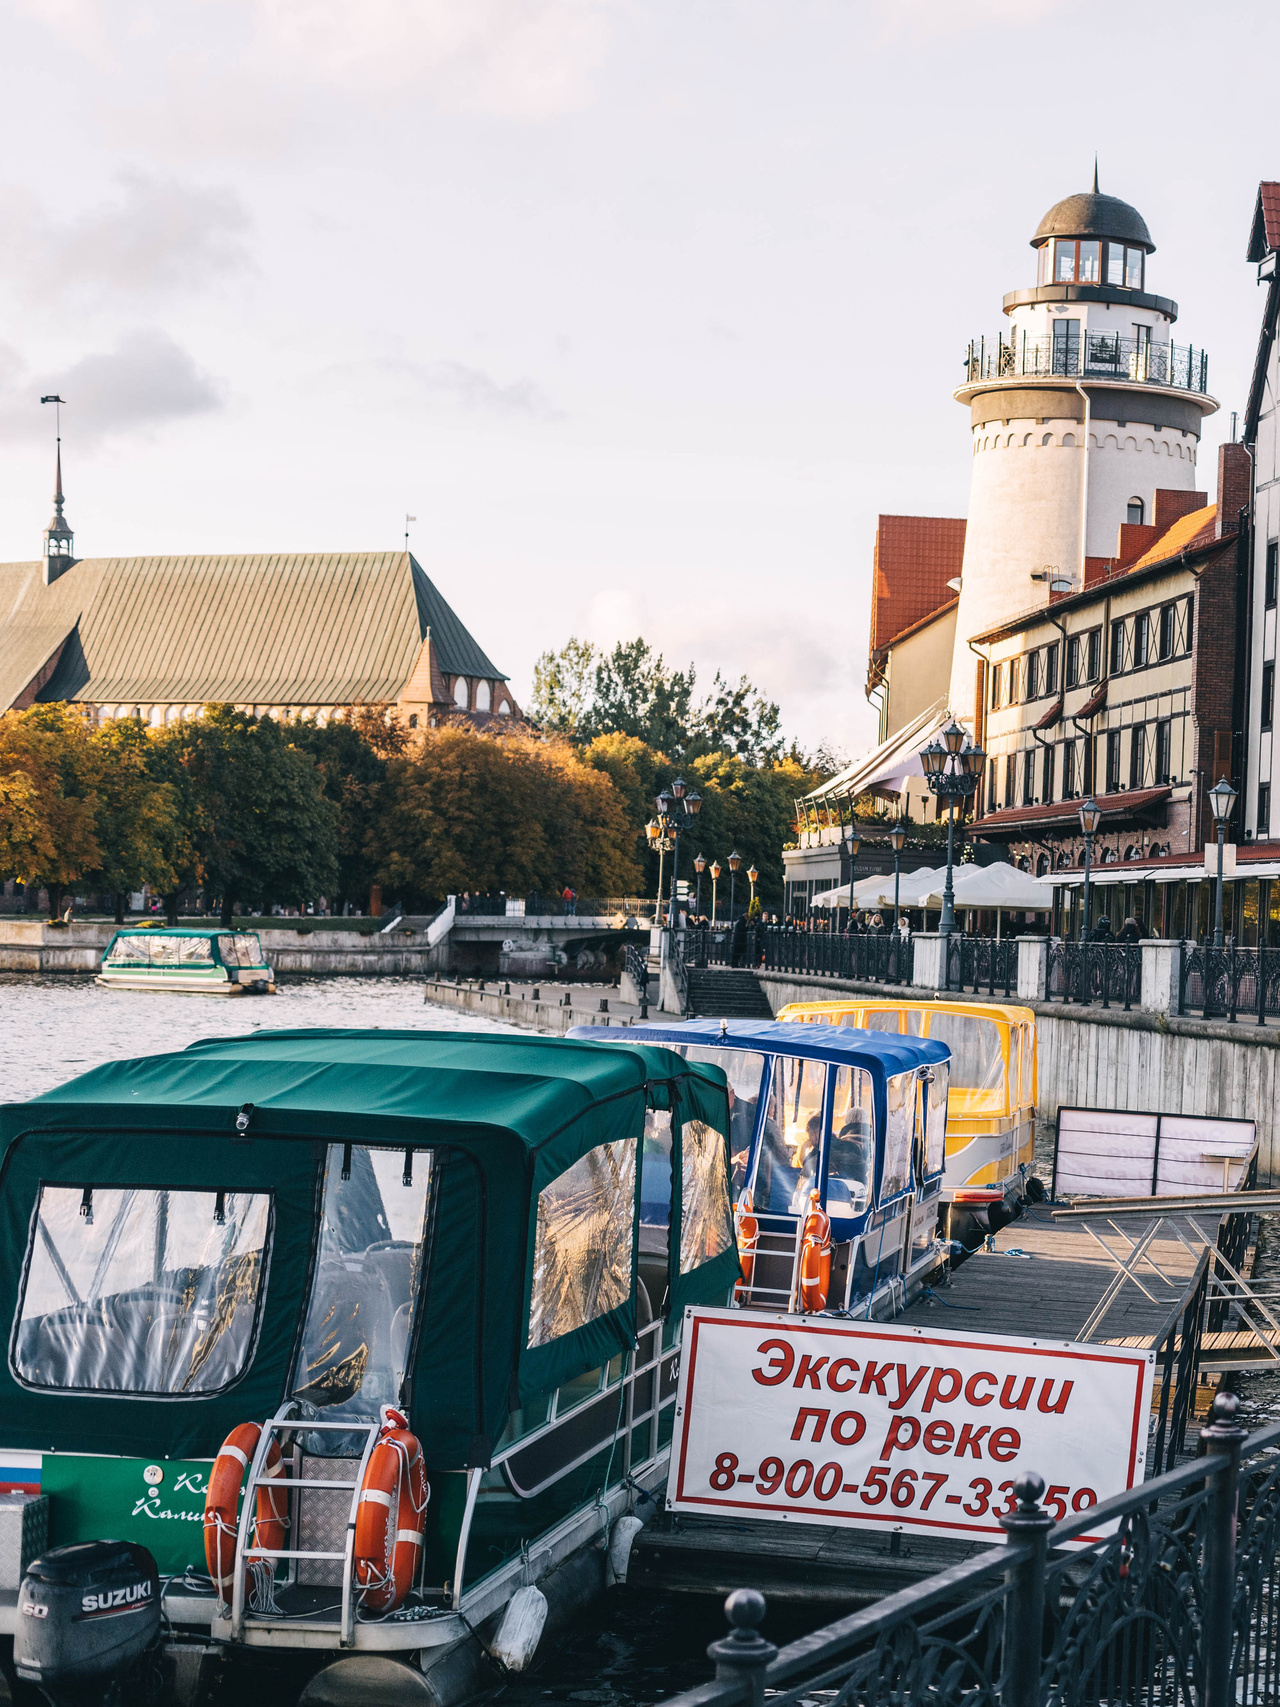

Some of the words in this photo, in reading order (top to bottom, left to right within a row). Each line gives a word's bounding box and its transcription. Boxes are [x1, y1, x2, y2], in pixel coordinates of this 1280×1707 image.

[751, 1338, 1075, 1414] Экскурсии
[790, 1406, 867, 1446] по
[878, 1415, 1022, 1462] реке
[708, 1451, 1098, 1522] 8-900-567-3359
[81, 1580, 152, 1613] SUZUKI
